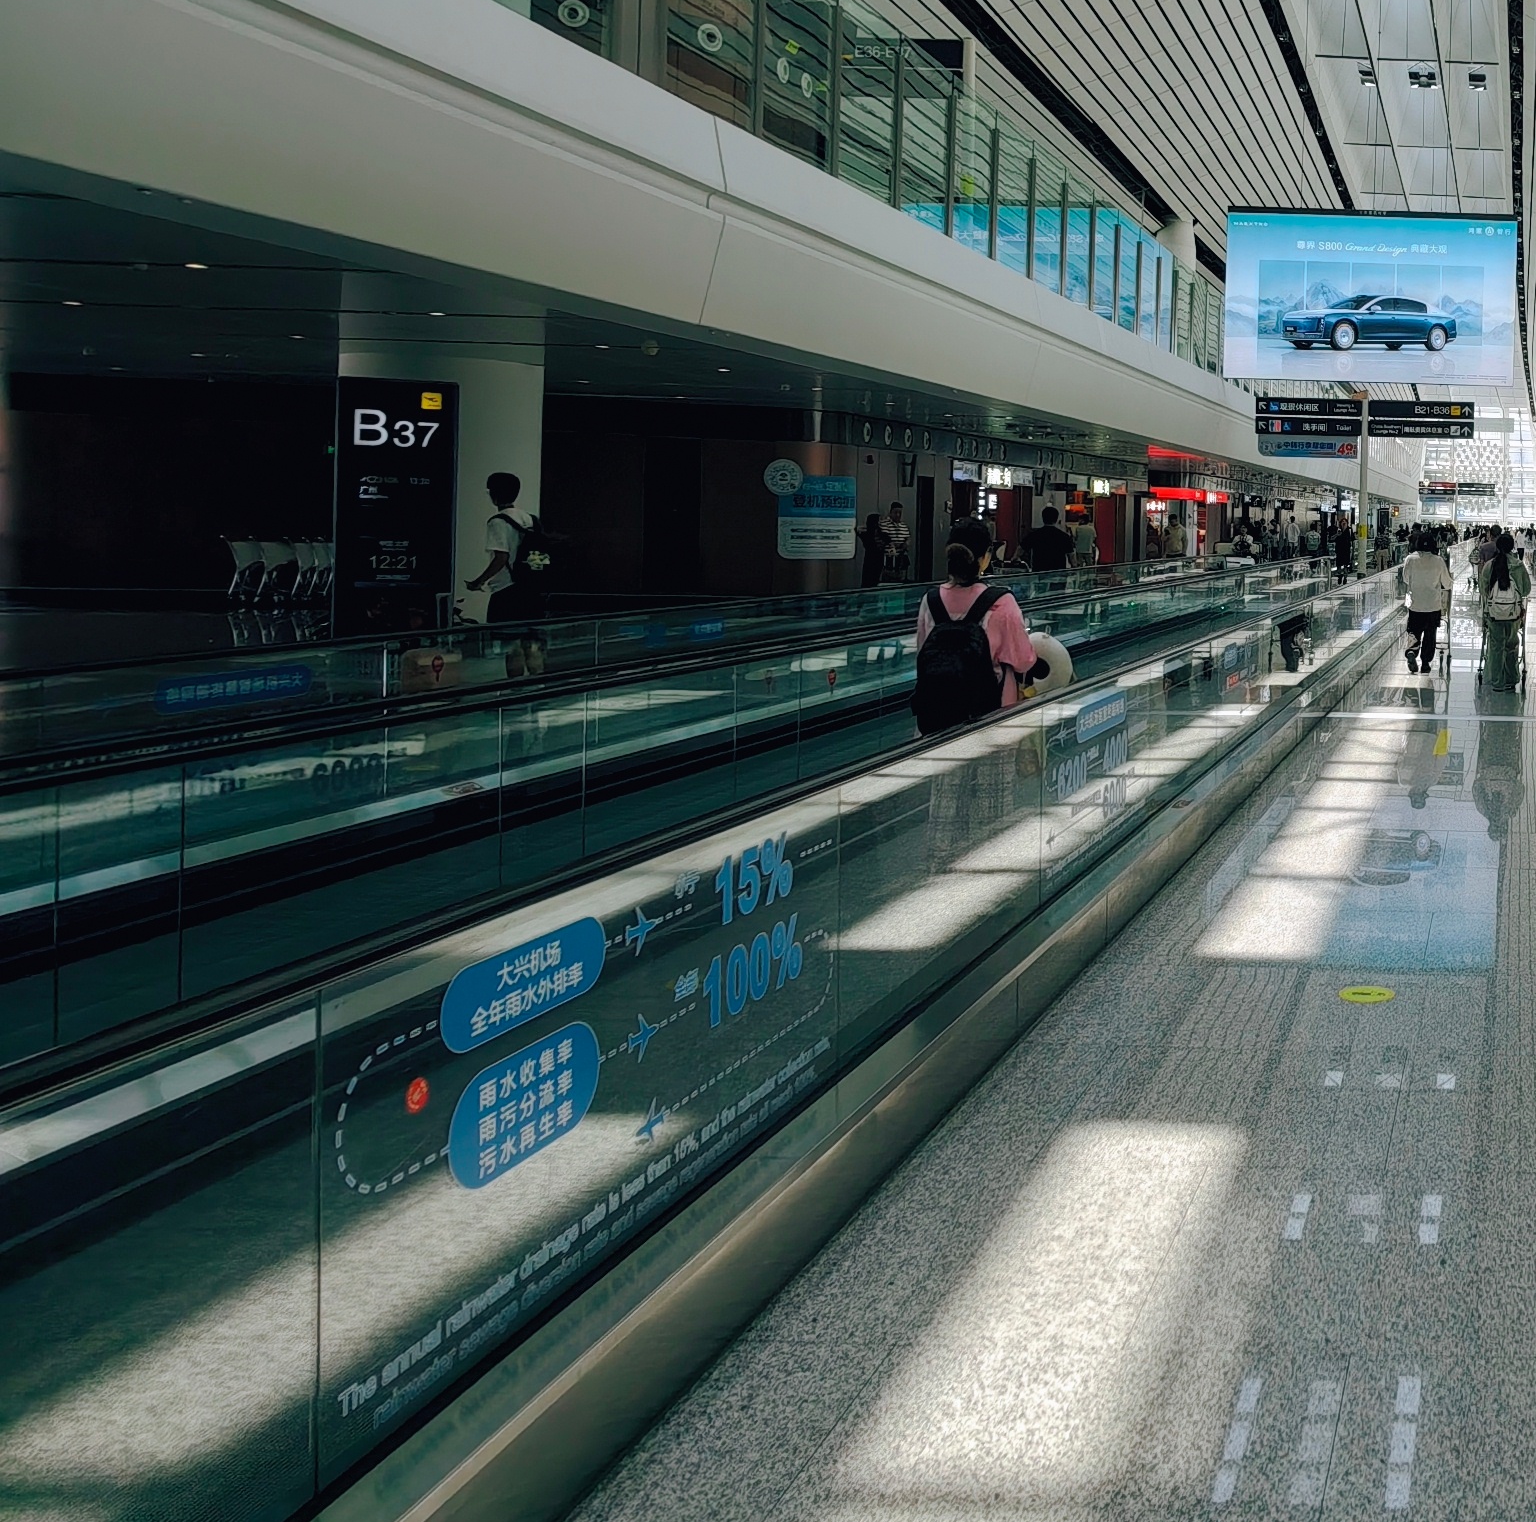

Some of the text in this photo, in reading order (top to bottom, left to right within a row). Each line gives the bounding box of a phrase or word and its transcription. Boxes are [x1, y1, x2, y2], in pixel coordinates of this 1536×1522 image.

[1318, 241, 1343, 252] S800
[1345, 242, 1376, 253] Grand
[1377, 243, 1408, 257] Design
[1410, 244, 1448, 255] 典藏大观
[353, 409, 440, 448] B37
[1302, 422, 1326, 432] 洗手间
[1336, 424, 1352, 432] Toilet
[369, 555, 417, 570] 12:21
[715, 831, 794, 926] 15%
[470, 961, 584, 1038] 全年雨水外排率
[496, 939, 562, 992] 大兴机场
[703, 912, 803, 1029] 100%
[479, 1037, 573, 1112] 雨水收集率
[479, 1068, 573, 1147] 雨污分流率
[479, 1099, 573, 1180] 污水再生率
[338, 1375, 377, 1417] The
[381, 1319, 442, 1386] annual
[446, 1268, 518, 1338] rainwater
[519, 1223, 580, 1280] drainage
